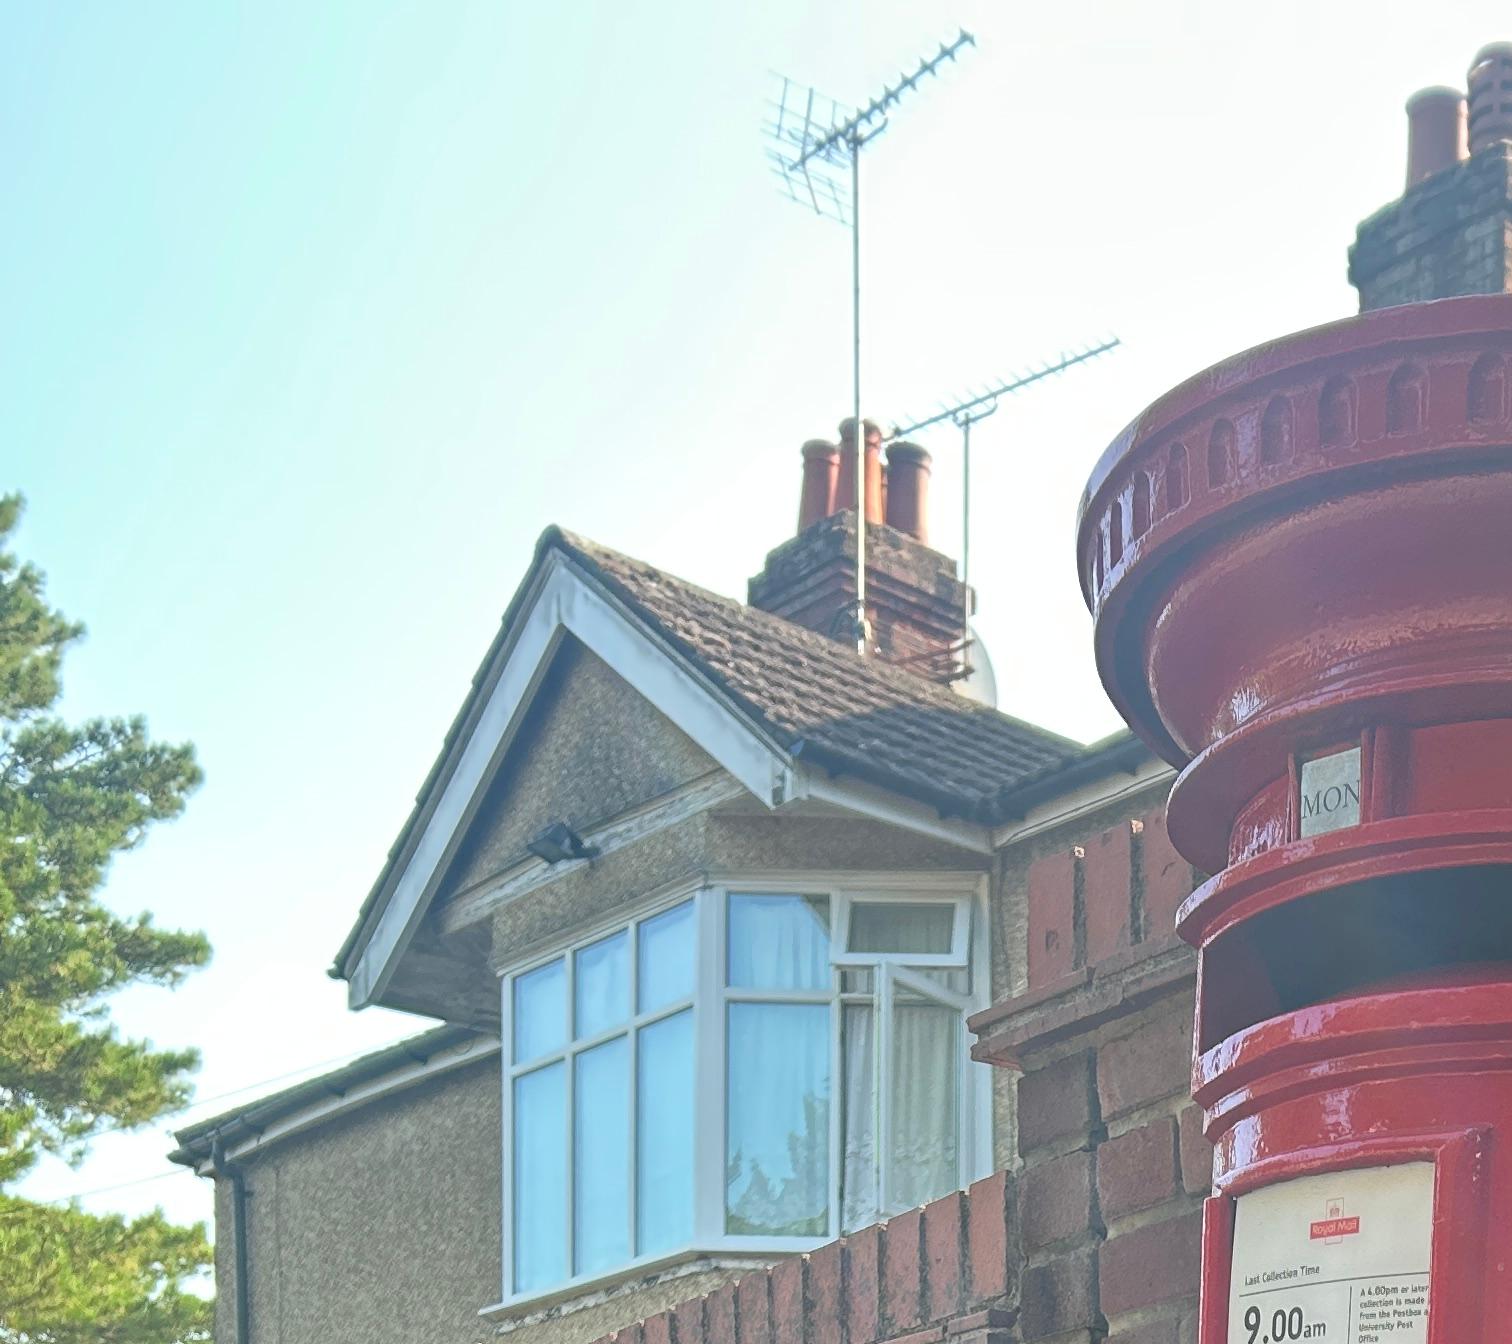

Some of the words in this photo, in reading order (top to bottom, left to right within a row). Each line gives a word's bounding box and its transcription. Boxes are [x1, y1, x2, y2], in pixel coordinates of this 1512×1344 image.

[1301, 780, 1361, 819] MON
[1312, 1223, 1336, 1236] Royal
[1337, 1219, 1357, 1232] Mail
[1245, 1273, 1260, 1286] Last
[1262, 1268, 1298, 1283] Collection
[1300, 1265, 1320, 1276] Time
[1368, 1285, 1398, 1297] 6.00pm
[1360, 1298, 1394, 1308] collection
[1405, 1296, 1425, 1305] made
[1360, 1311, 1376, 1320] from
[1379, 1309, 1390, 1318] the
[1397, 1320, 1413, 1329] Post
[1358, 1334, 1378, 1344] Office
